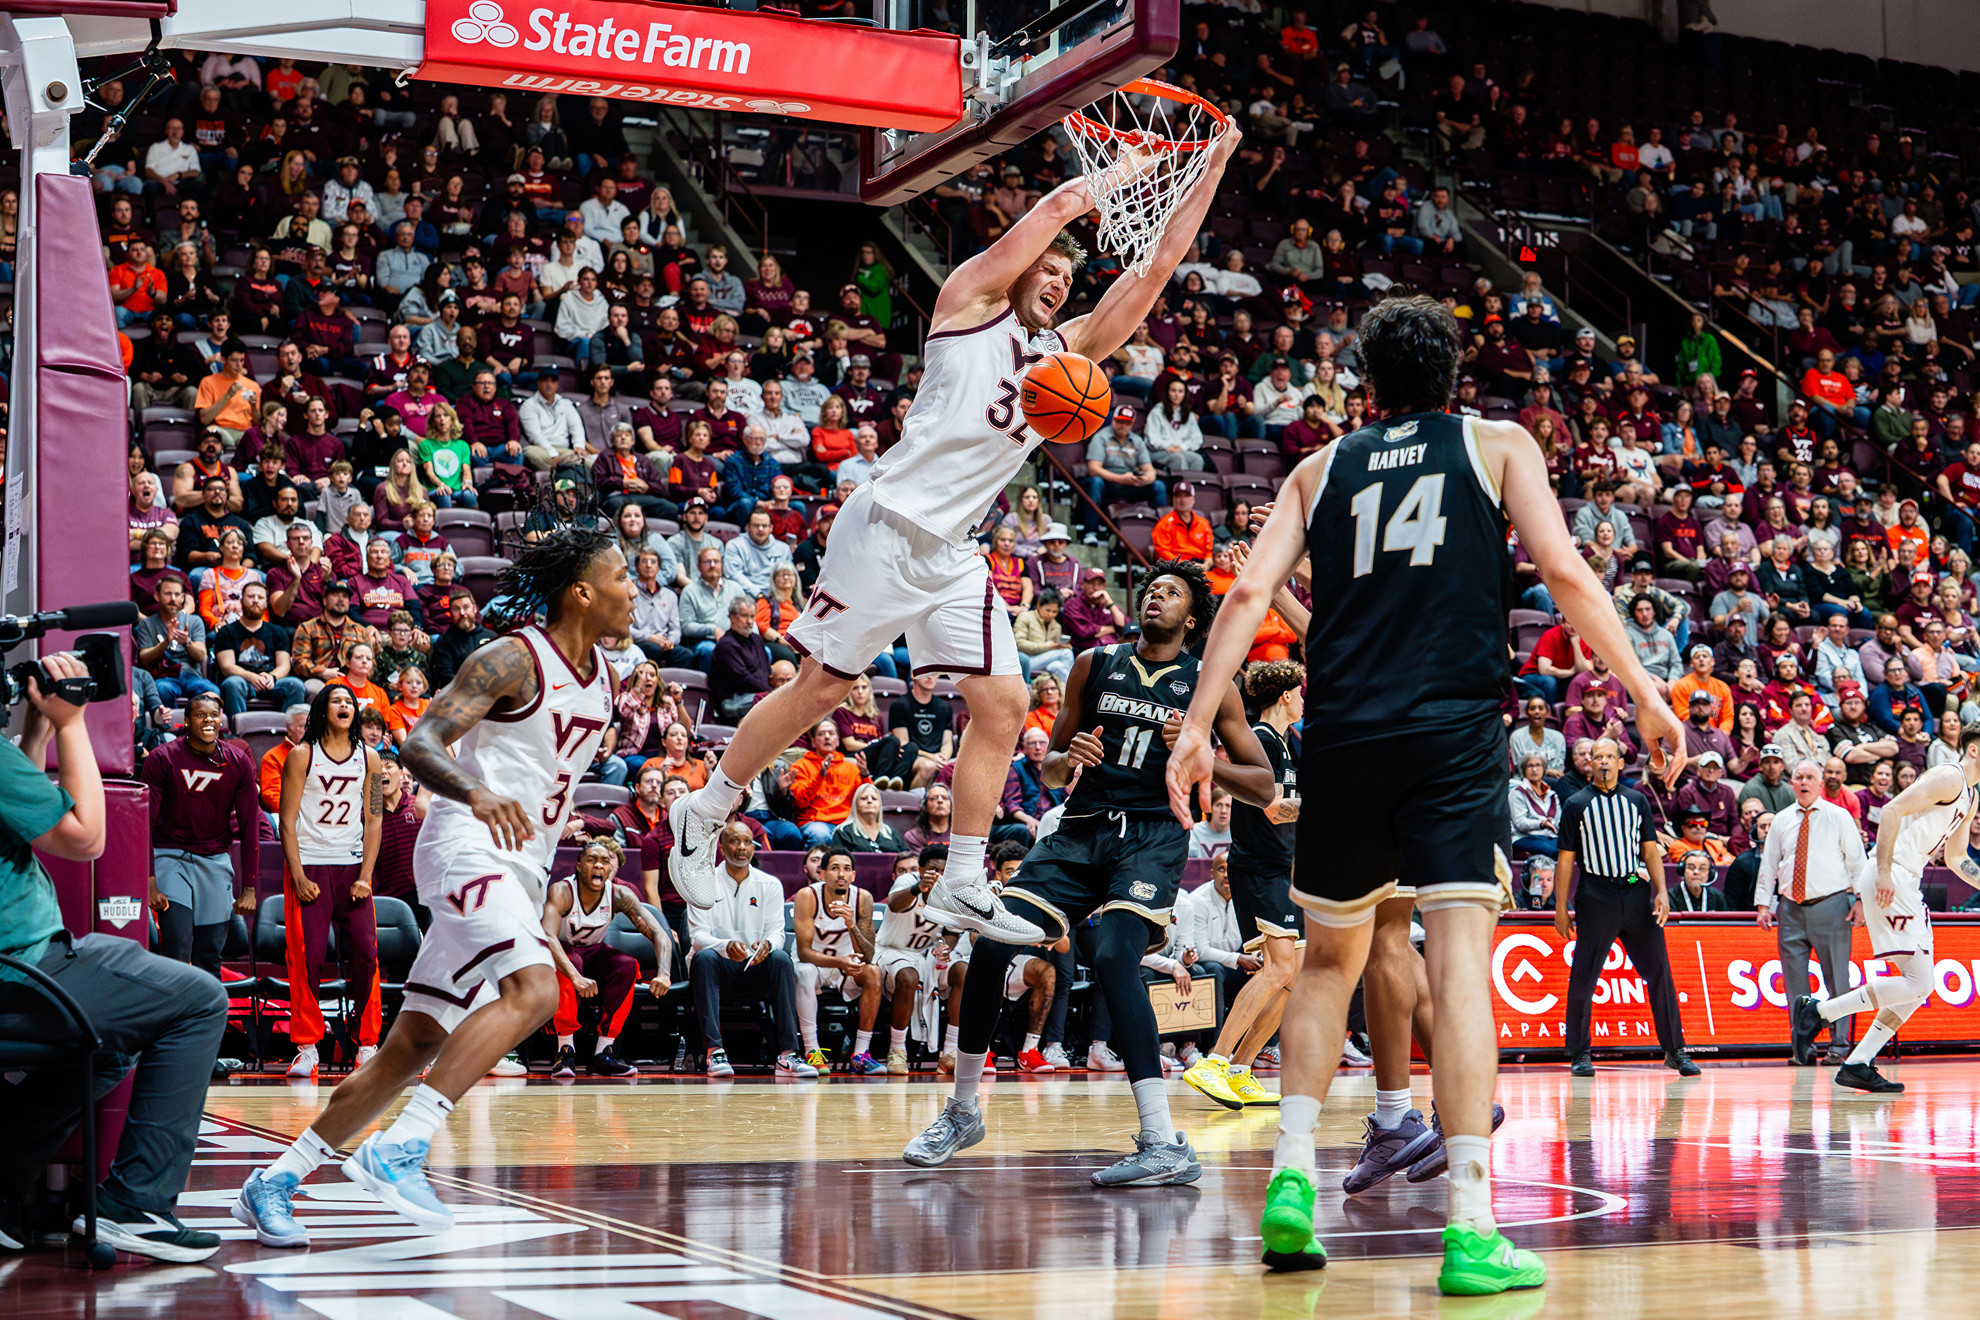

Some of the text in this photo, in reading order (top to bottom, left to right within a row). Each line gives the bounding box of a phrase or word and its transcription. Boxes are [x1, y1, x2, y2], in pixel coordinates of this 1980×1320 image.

[1368, 443, 1427, 471] HARVEY
[1350, 473, 1447, 578] 14
[547, 708, 609, 760] VT
[1117, 726, 1155, 770] 11
[180, 768, 224, 792] VT
[315, 774, 359, 796] VT
[541, 769, 574, 829] 3
[316, 800, 352, 826] 22
[445, 872, 507, 918] VT
[103, 905, 138, 917] HUDDLE
[1885, 914, 1915, 931] VT
[905, 933, 932, 950] 10
[1174, 1001, 1191, 1012] VT
